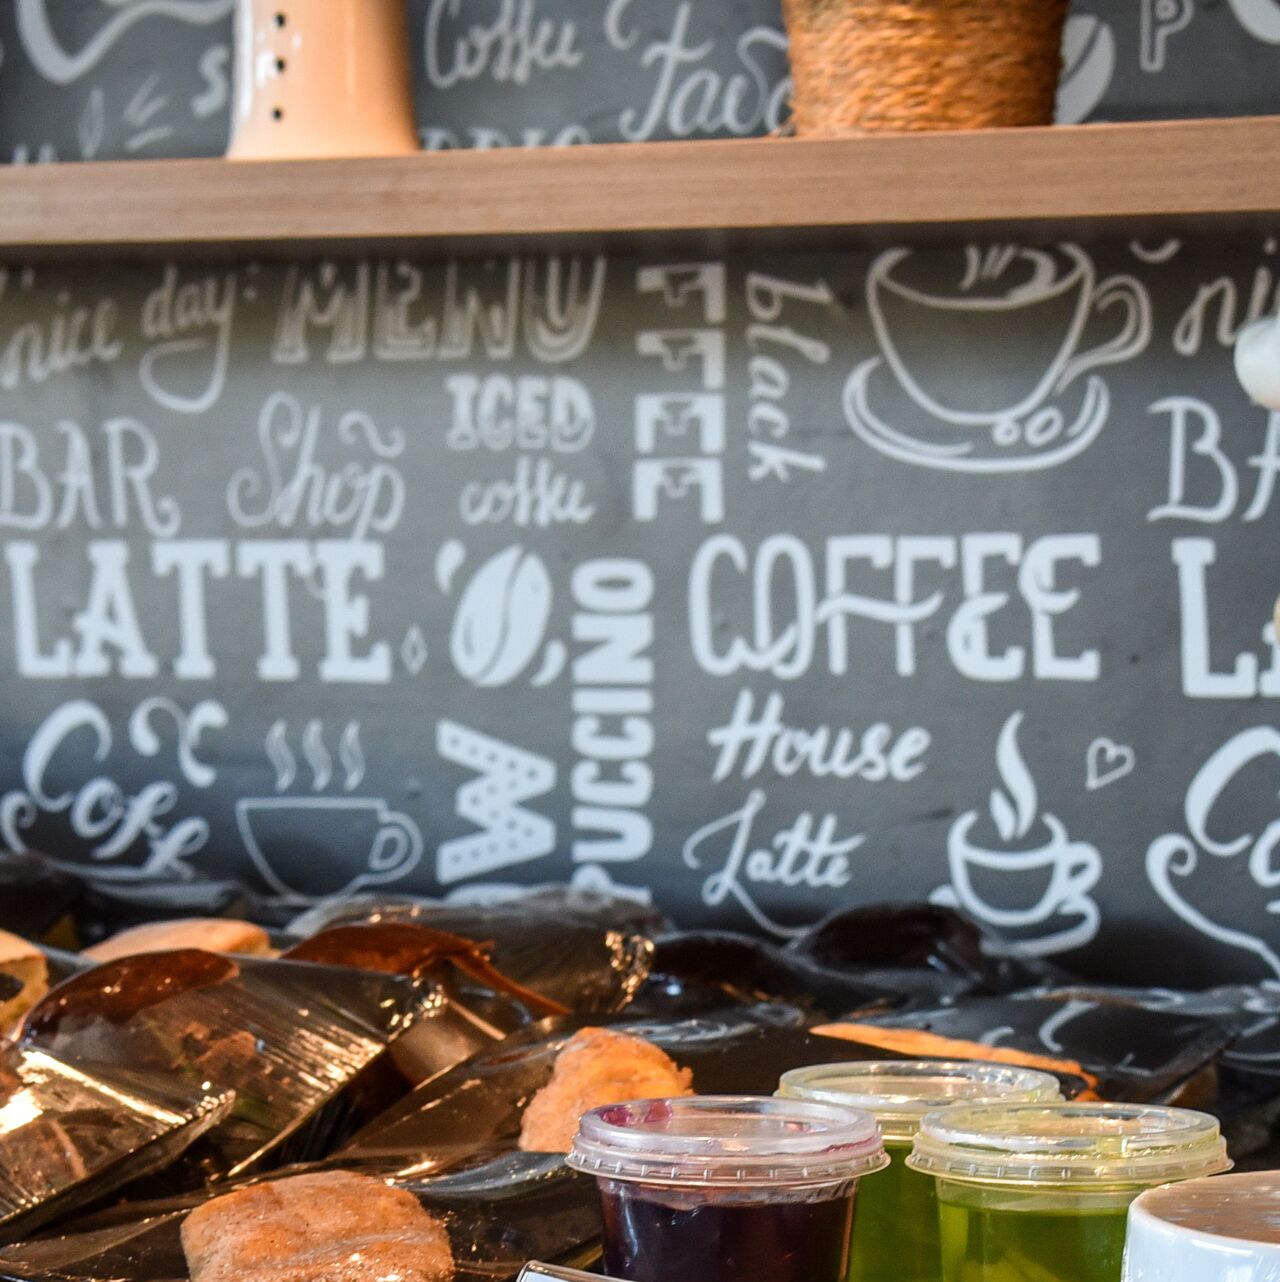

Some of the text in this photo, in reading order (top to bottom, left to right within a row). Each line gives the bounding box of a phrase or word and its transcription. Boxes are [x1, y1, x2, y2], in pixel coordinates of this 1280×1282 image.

[442, 371, 598, 455] ICED
[745, 270, 834, 484] black
[226, 388, 407, 545] Shop
[4, 536, 393, 683] LATTE
[687, 533, 1101, 682] COFFEE
[706, 687, 933, 783] House
[681, 788, 867, 938] Latte
